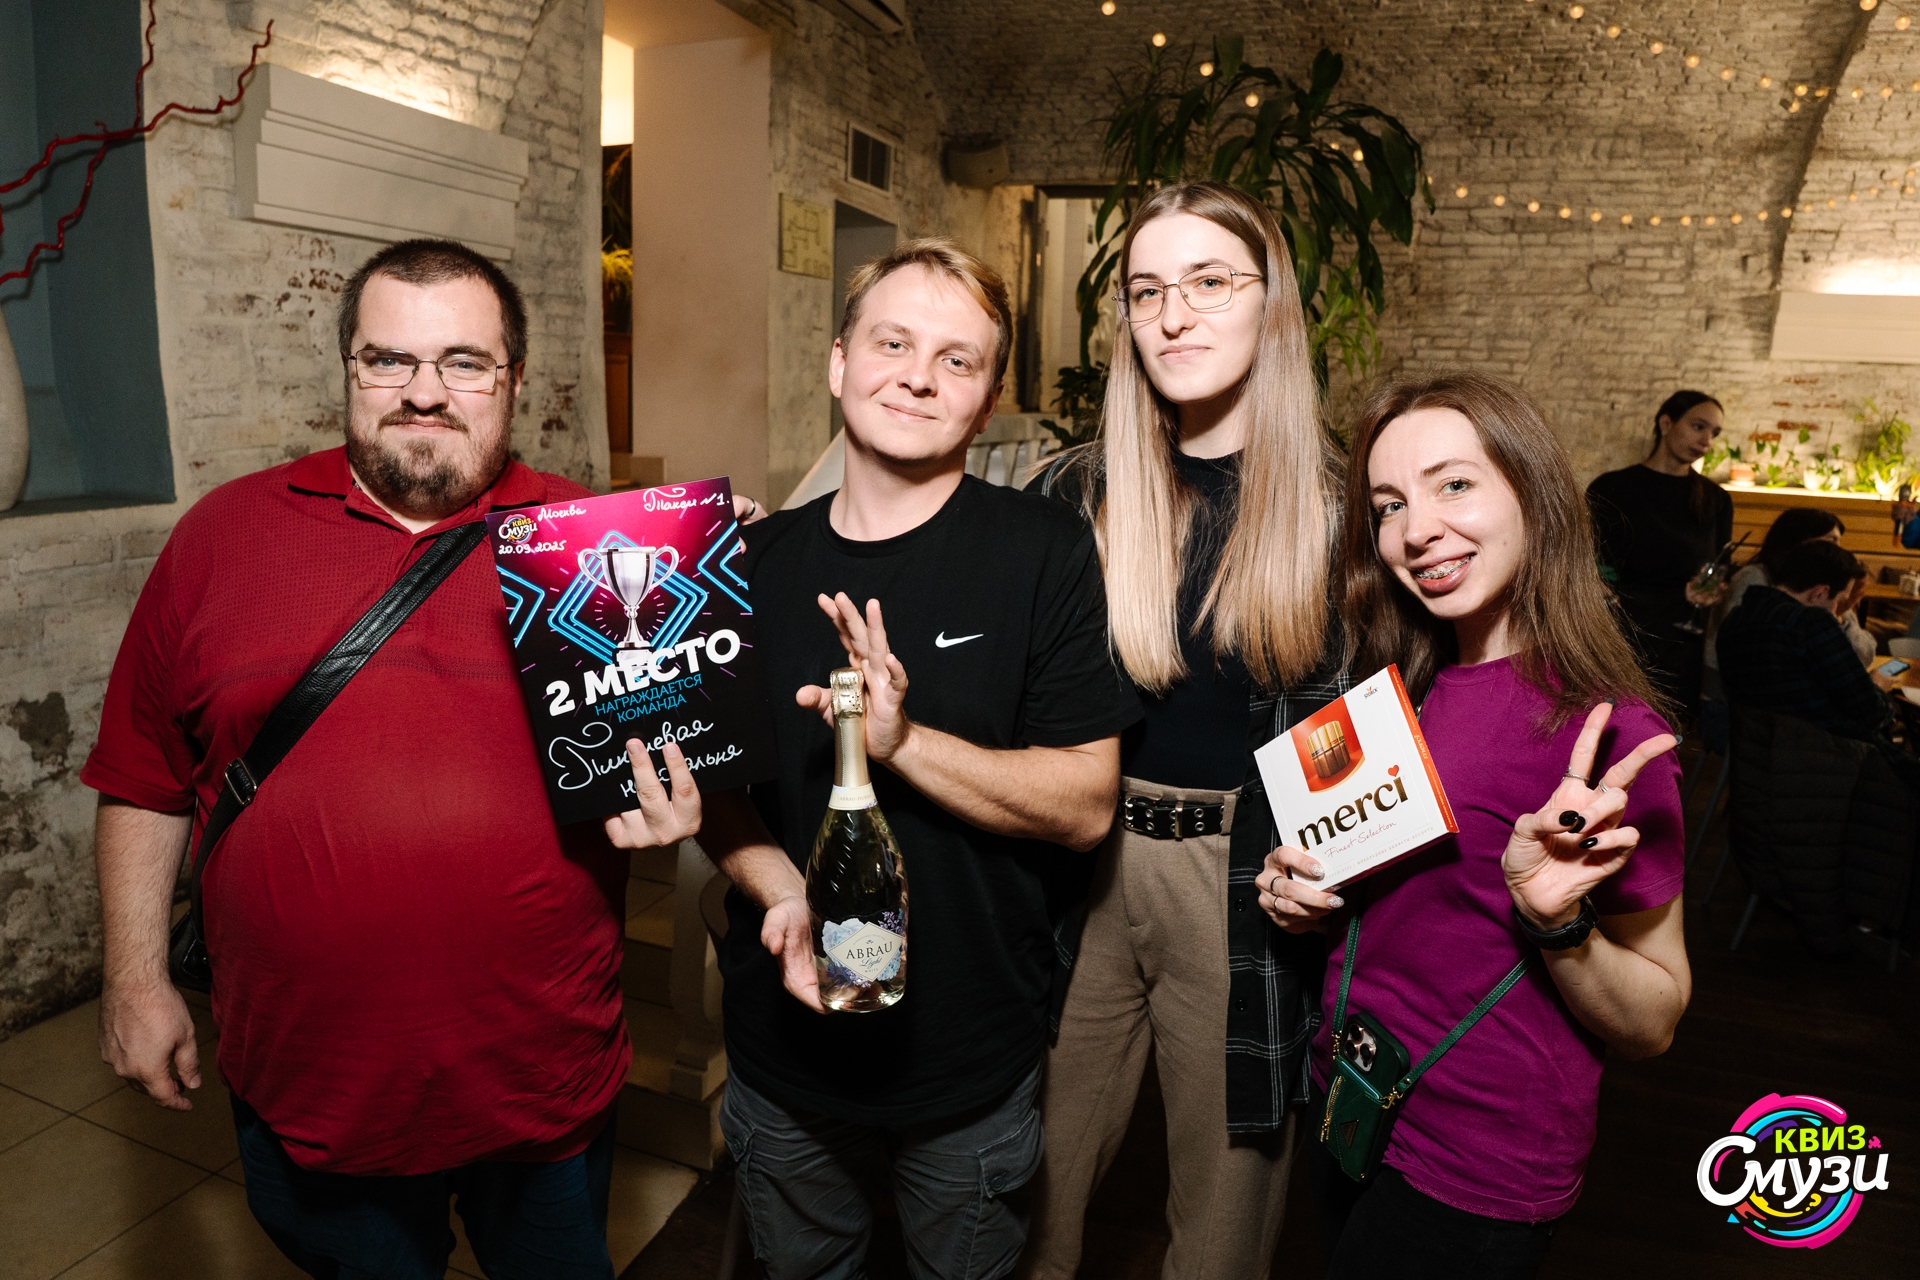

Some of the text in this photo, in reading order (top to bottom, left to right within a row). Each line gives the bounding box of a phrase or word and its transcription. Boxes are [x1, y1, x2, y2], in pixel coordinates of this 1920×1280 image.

[512, 518, 531, 527] КВИЗ
[537, 504, 587, 521] Москва
[498, 540, 567, 555] 20.09.2025
[546, 629, 741, 717] 2 МЕСТО
[594, 673, 703, 717] НАГРАЖДАЕТСЯ
[616, 693, 687, 723] КОМАНДА
[1297, 766, 1409, 852] merci
[1324, 822, 1397, 858] Finest Selection
[846, 941, 893, 960] ABRAU
